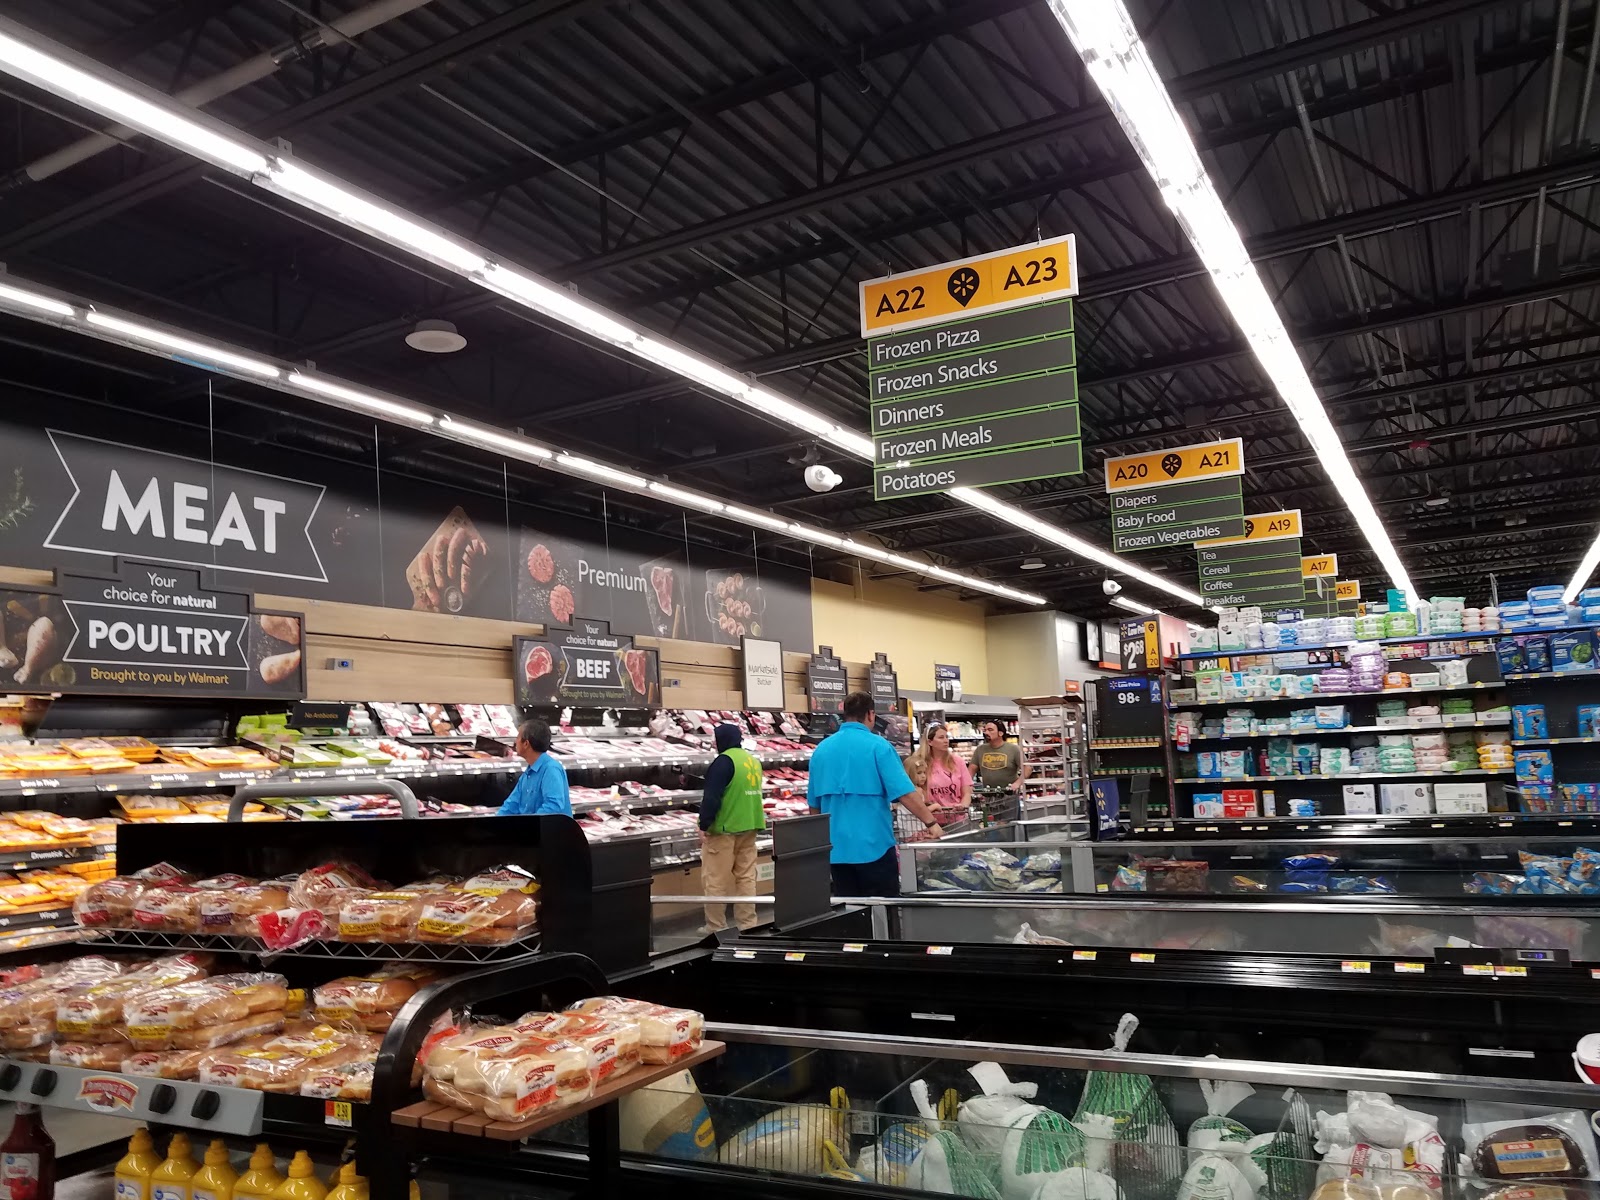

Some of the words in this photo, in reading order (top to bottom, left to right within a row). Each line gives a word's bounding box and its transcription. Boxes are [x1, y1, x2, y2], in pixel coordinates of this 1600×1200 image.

[1003, 256, 1058, 291] A23
[875, 286, 926, 318] A22
[876, 338, 932, 362] Frozen
[936, 328, 980, 350] Pizza
[877, 371, 933, 395] Frozen
[937, 358, 998, 383] Snacks
[879, 402, 944, 427] Dinners
[880, 436, 937, 460] Frozen
[942, 425, 992, 450] Meals
[1199, 451, 1230, 469] A21
[882, 469, 956, 493] Potatoes
[1114, 463, 1148, 482] A20
[1115, 493, 1158, 510] Diapers
[101, 469, 286, 554] MEAT
[1117, 515, 1145, 530] Baby
[1146, 510, 1176, 525] Food
[1267, 519, 1291, 533] A19
[1118, 533, 1156, 548] Frozen
[1157, 525, 1220, 544] Vegetables
[1201, 551, 1217, 561] Tea
[1202, 564, 1230, 576] Cereal
[1309, 560, 1329, 572] A17
[147, 571, 178, 589] Your
[578, 559, 648, 593] Premium
[1203, 580, 1233, 591] Coffee
[103, 585, 149, 603] choice
[151, 589, 171, 605] for
[173, 594, 217, 610] natural
[1205, 595, 1246, 606] Breakfast
[1336, 586, 1353, 596] A15
[88, 619, 232, 657] POULTRY
[585, 623, 600, 635] Your
[566, 634, 587, 645] choice
[587, 635, 597, 646] for
[597, 638, 618, 648] natural
[90, 667, 136, 684] Brought
[138, 670, 151, 682] to
[152, 673, 172, 685] you
[173, 671, 187, 686] by
[187, 671, 230, 685] Walmart
[576, 658, 611, 679] BEEF
